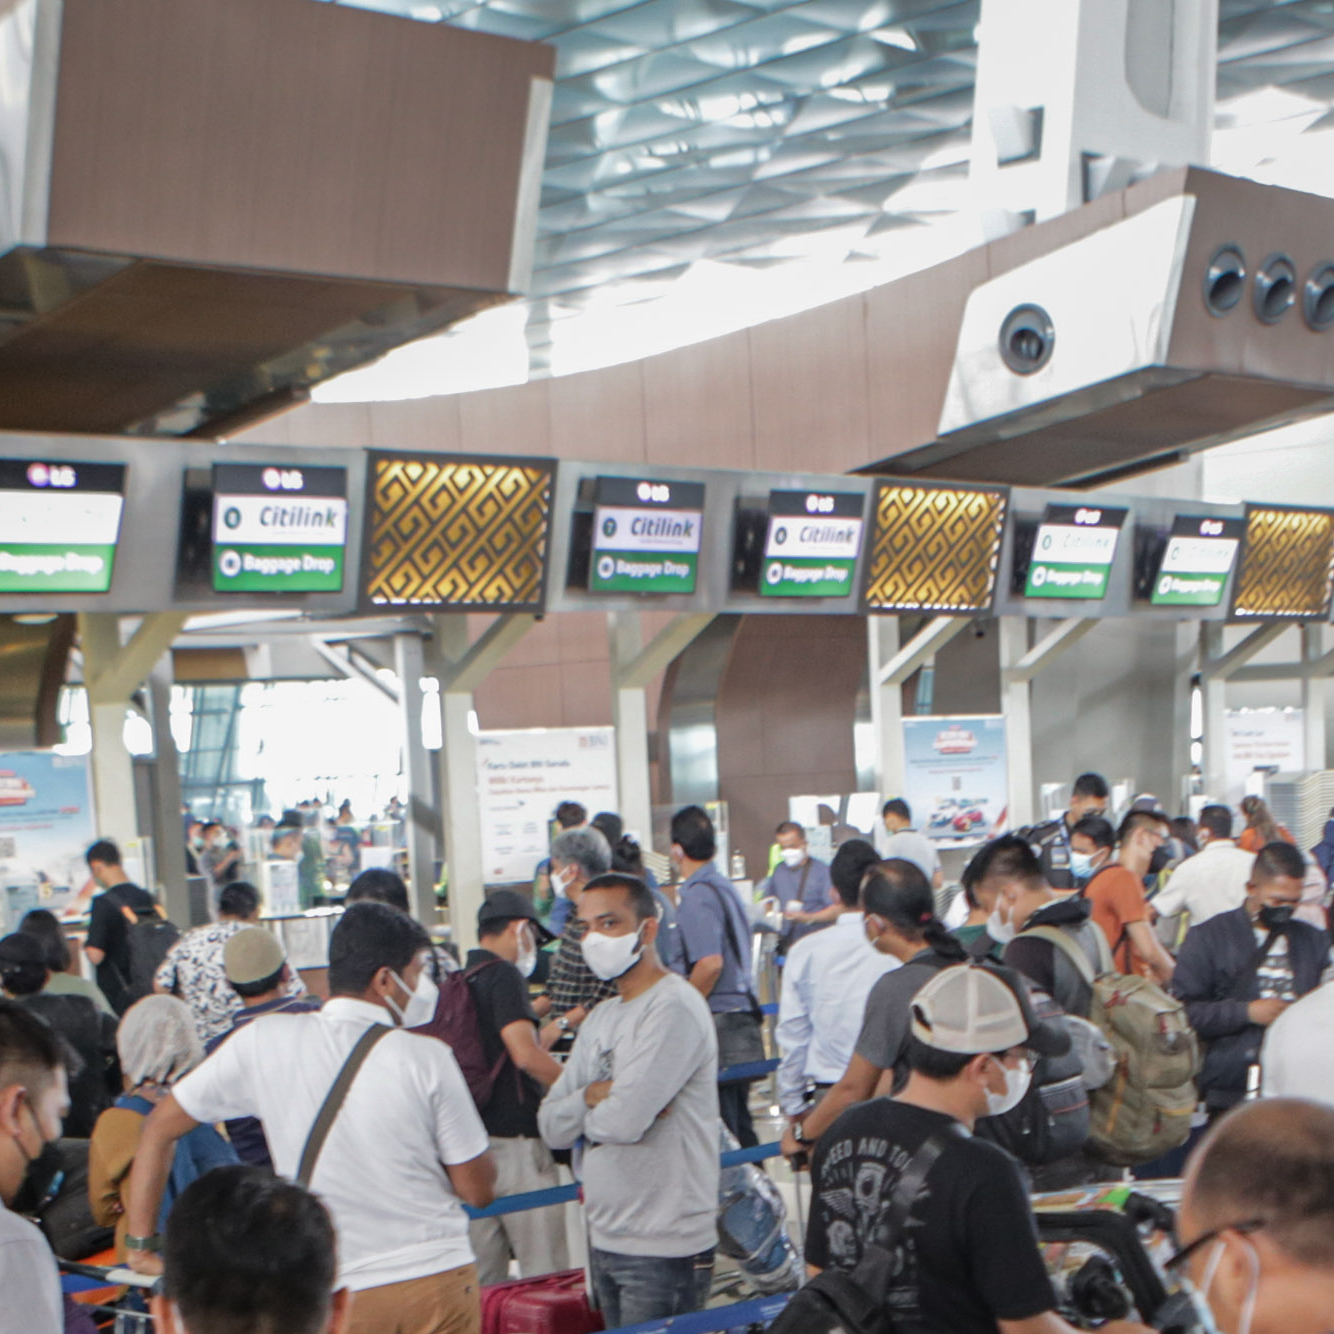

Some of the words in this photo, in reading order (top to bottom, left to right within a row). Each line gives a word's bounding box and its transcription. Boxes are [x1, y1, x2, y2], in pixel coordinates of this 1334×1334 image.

[259, 505, 337, 527] Citilink
[631, 517, 694, 537] Citilink
[799, 526, 854, 544] Citilink
[243, 553, 302, 575] Baggage
[302, 554, 335, 575] Drop
[616, 559, 662, 578] Baggage
[663, 560, 690, 578] Drop
[783, 565, 825, 584] Baggage
[824, 565, 849, 583] Drop
[857, 1137, 888, 1159] AND
